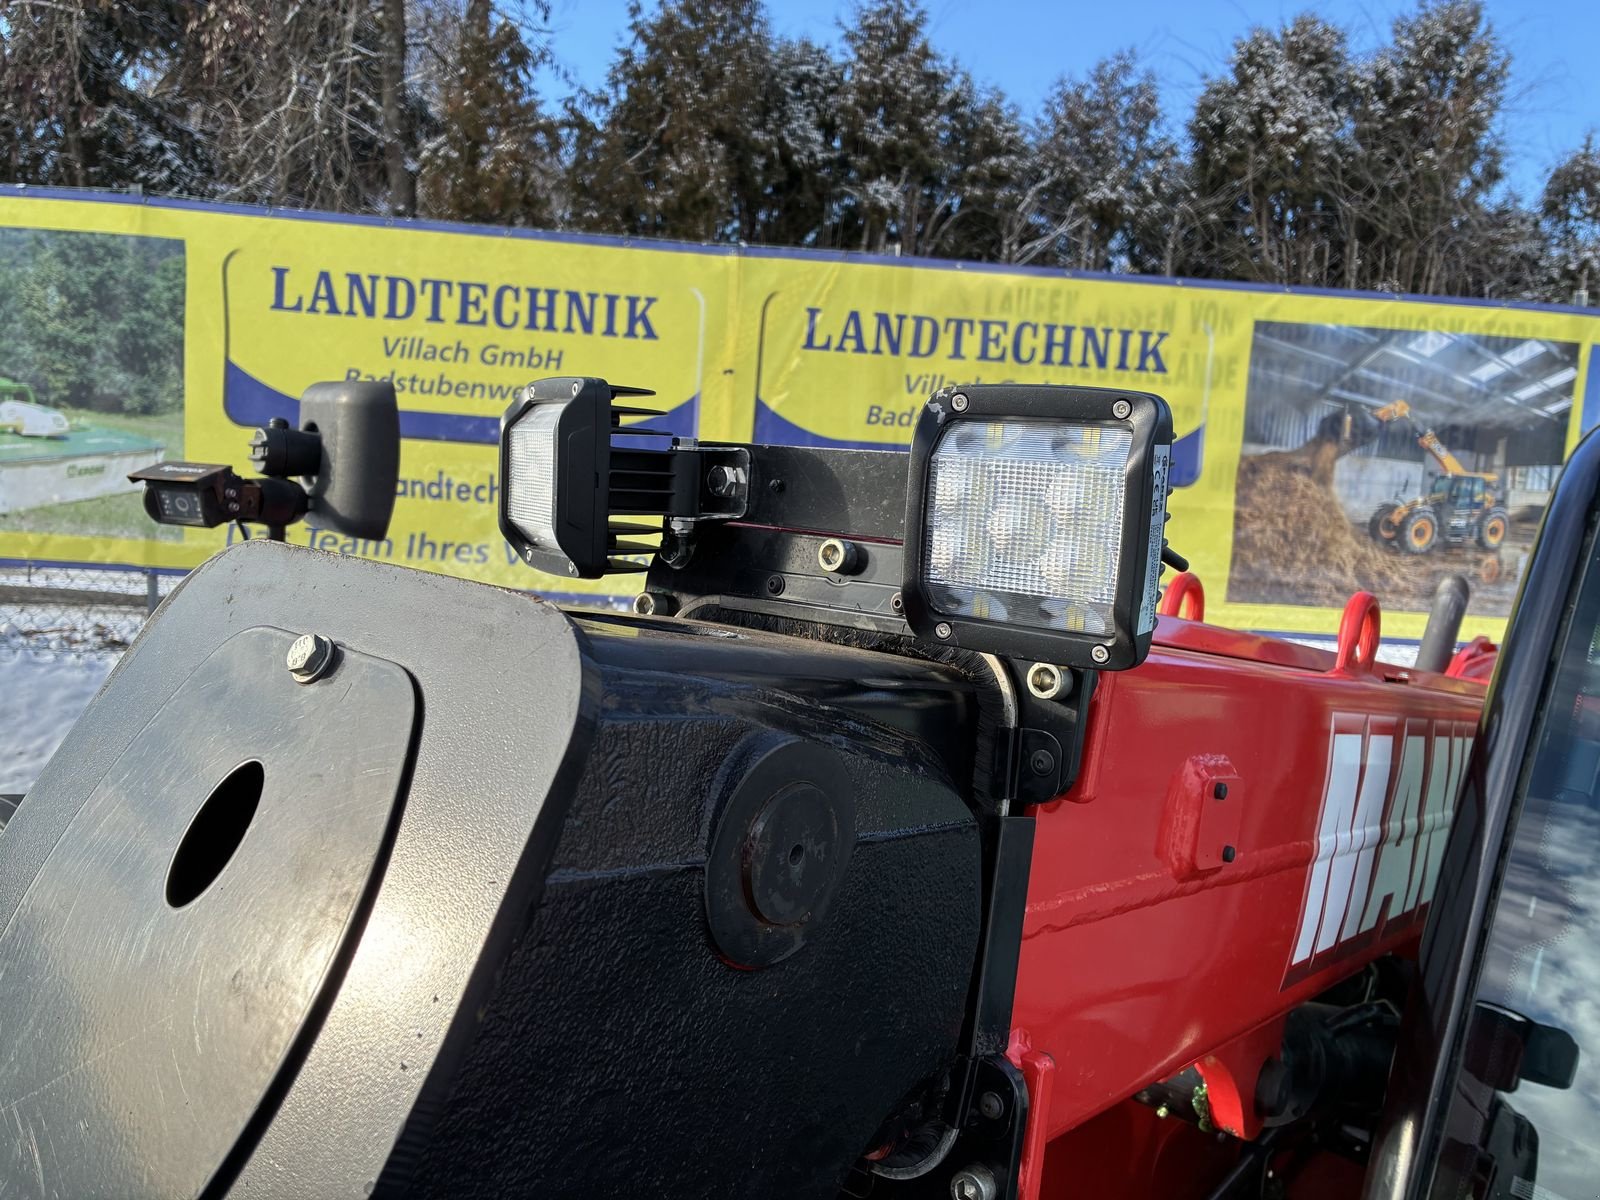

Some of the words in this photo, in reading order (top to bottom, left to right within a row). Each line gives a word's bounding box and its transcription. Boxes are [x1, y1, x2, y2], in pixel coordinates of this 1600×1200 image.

[270, 266, 659, 340] LANDTECHNIK
[382, 335, 469, 364] Villach
[479, 343, 563, 371] GmbH
[802, 307, 1169, 374] LANDTECHNIK
[866, 405, 919, 428] Bad
[406, 531, 490, 564] Ihres
[1290, 731, 1475, 967] MAN
